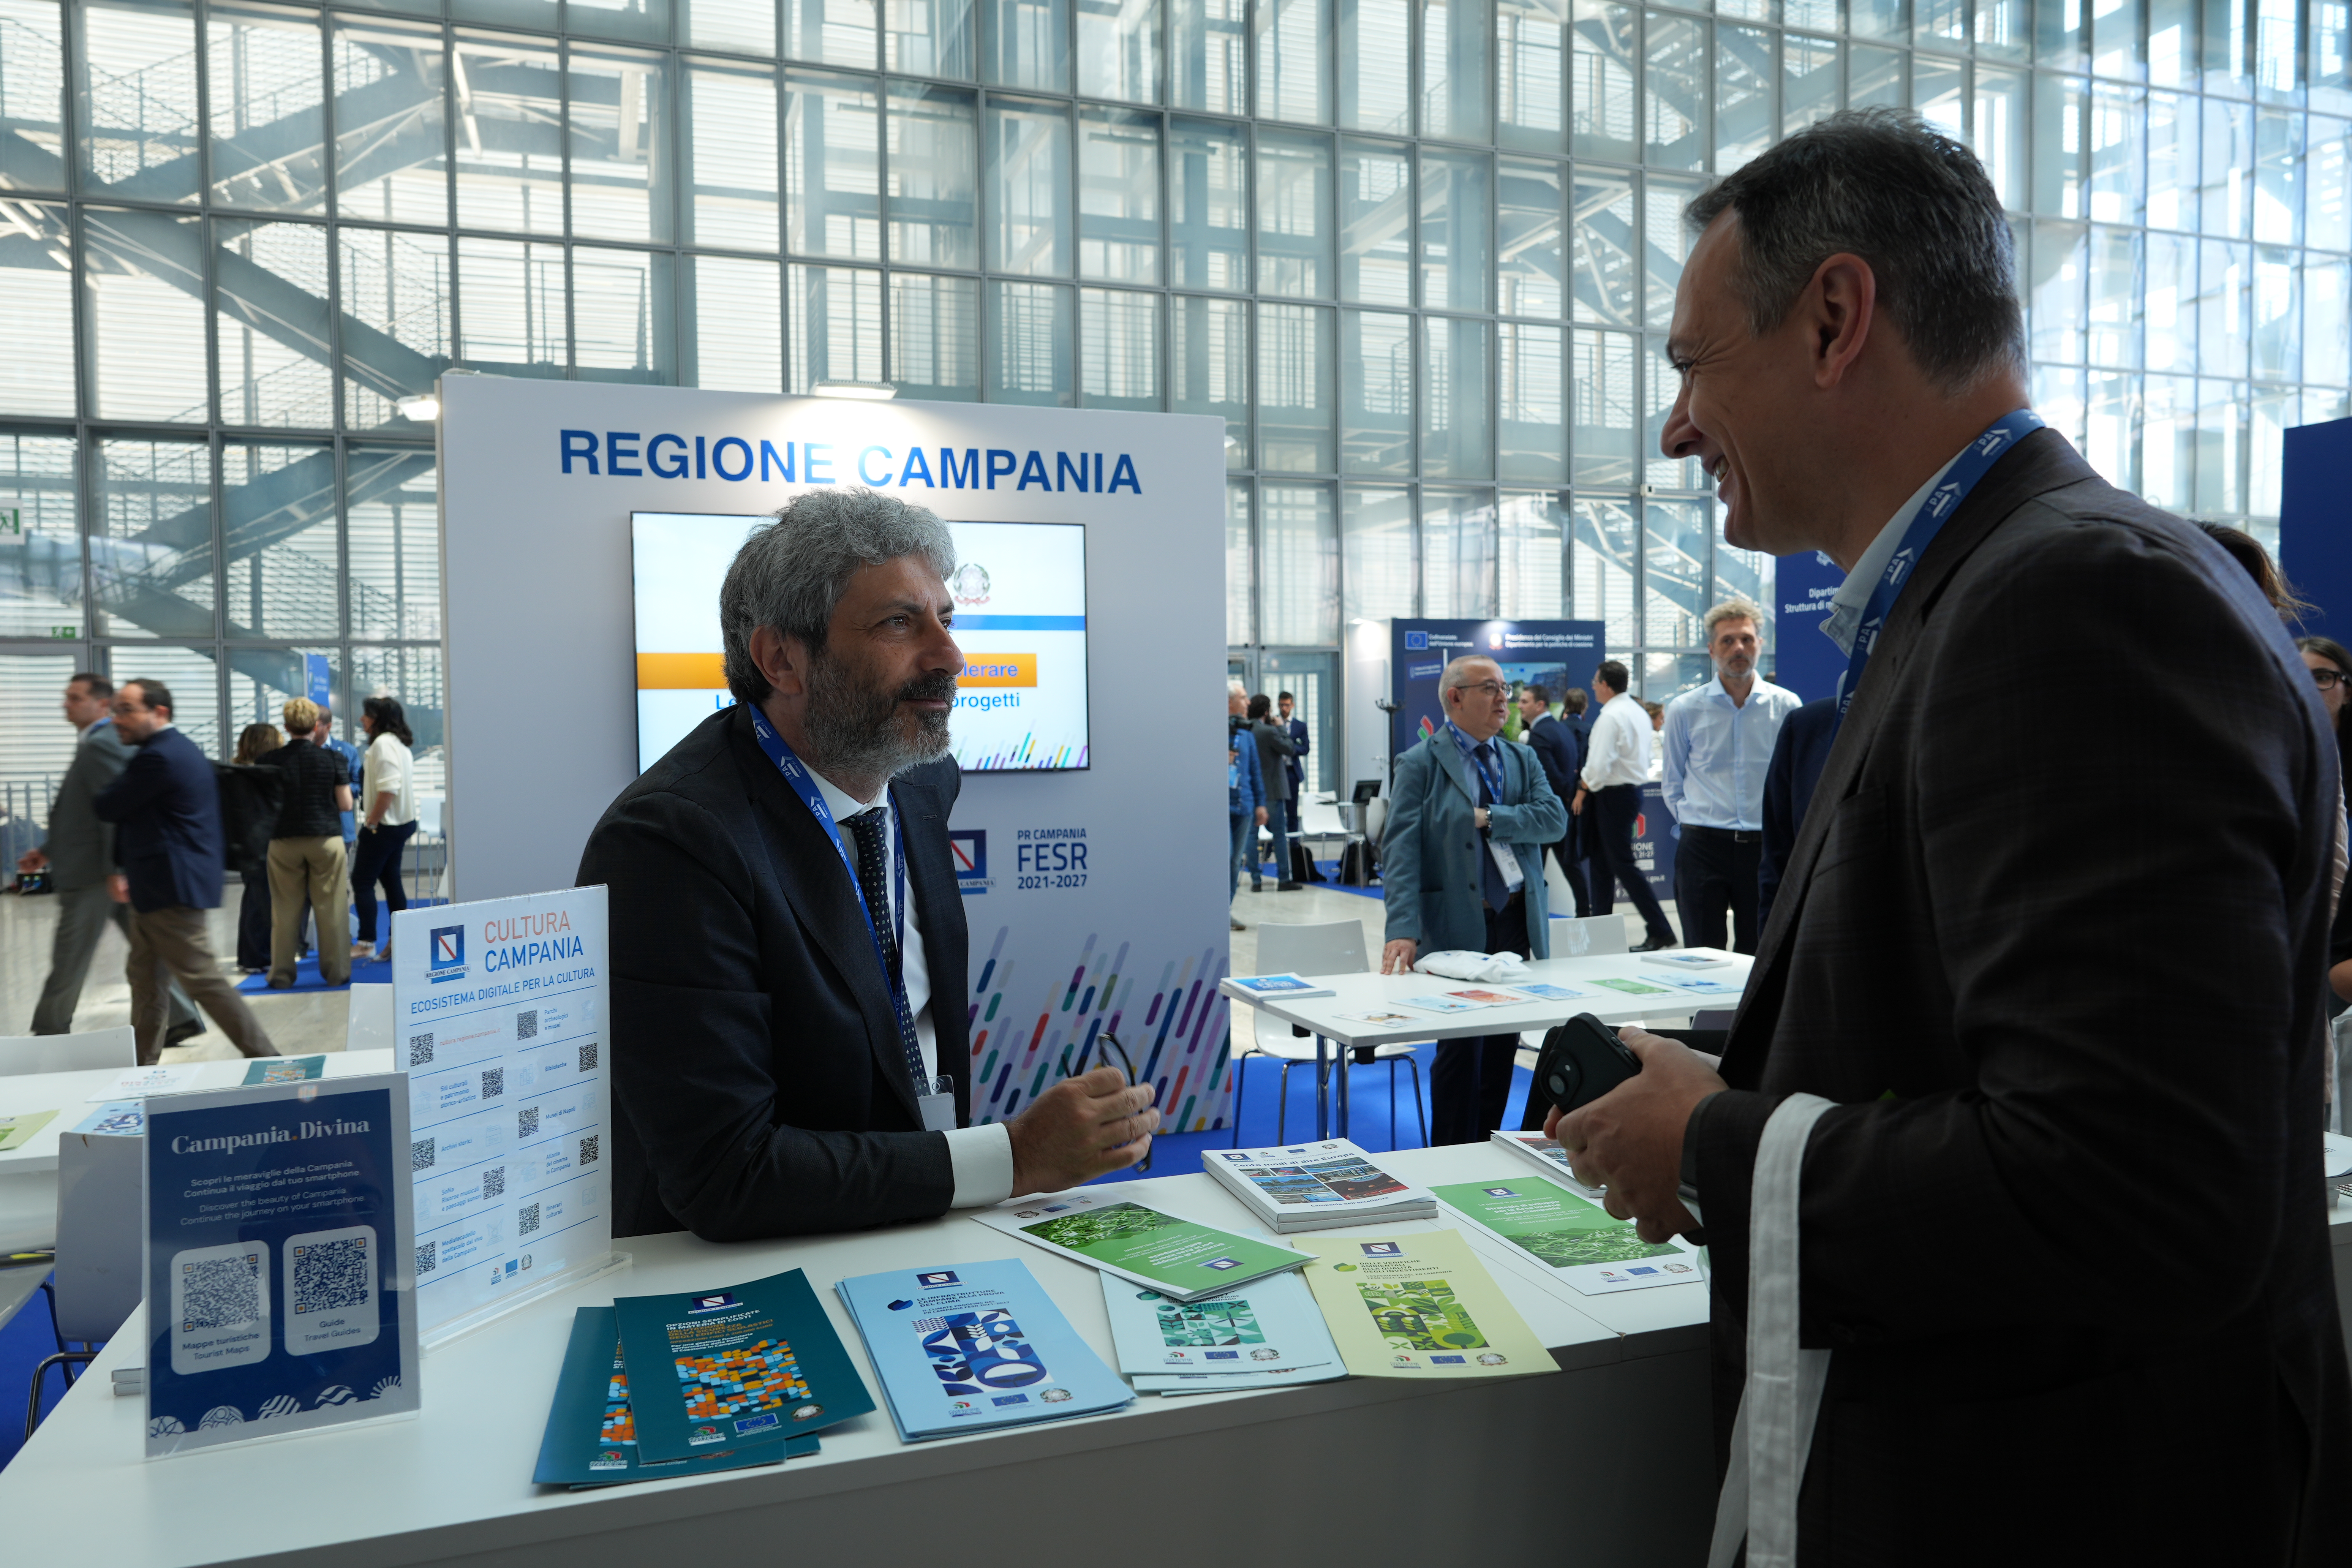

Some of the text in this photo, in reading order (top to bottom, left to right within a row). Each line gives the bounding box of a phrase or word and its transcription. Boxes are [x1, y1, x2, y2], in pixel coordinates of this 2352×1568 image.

[560, 429, 1142, 495] REGIONE CAMPANIA
[1809, 586, 1841, 599] Dipartim
[1785, 603, 1816, 613] Struttura
[957, 662, 1018, 677] lerare
[782, 766, 794, 780] FPA
[812, 806, 824, 820] FPA
[1018, 828, 1086, 840] PR CAMPANIA
[1018, 843, 1087, 872] FESR
[1018, 875, 1087, 889] 2021-2027
[485, 910, 571, 943] CULTURA
[485, 936, 583, 972] CAMPANIA
[411, 967, 595, 1014] ECOSISTEMA DIGITALE PER LA CULTURA
[544, 1013, 568, 1023] archeologici
[440, 1028, 500, 1045] cultura.regione.campania.it
[545, 1062, 567, 1072] Biblioteche
[449, 1080, 468, 1089] culturali
[445, 1088, 469, 1100] patrimonio
[299, 1119, 370, 1140] Divina
[441, 1138, 472, 1152] Archivi storici
[546, 1151, 560, 1159] Atlante
[553, 1156, 567, 1165] cinema
[1323, 1153, 1355, 1162] Europa
[551, 1163, 571, 1173] Campania
[191, 1175, 222, 1187] Scopri
[234, 1168, 282, 1182] meraviglie
[284, 1166, 306, 1175] della
[184, 1186, 227, 1198] Continua
[236, 1180, 270, 1193] viaggio
[271, 1177, 286, 1187] dal
[442, 1186, 479, 1203] Risorse musicali
[199, 1200, 239, 1213] Discover
[241, 1199, 256, 1207] the
[258, 1194, 289, 1207] beauty
[291, 1192, 300, 1200] of
[446, 1198, 466, 1211] paesaggi
[467, 1193, 482, 1203] sonori
[546, 1201, 562, 1211] Itinerari
[180, 1214, 223, 1226] Continue
[241, 1206, 275, 1219] journey
[291, 1203, 310, 1213] your
[546, 1208, 562, 1219] culturali
[442, 1242, 465, 1255] spettacolo
[454, 1246, 477, 1258] Campania
[928, 1290, 996, 1300] INFRASTRUTTURE
[319, 1317, 345, 1328] Guide
[702, 1310, 760, 1323] SEMPLIFICATE
[182, 1331, 259, 1352] Mappe turistiche
[304, 1327, 361, 1342] Travel Guides
[193, 1345, 250, 1360] Tourist Maps
